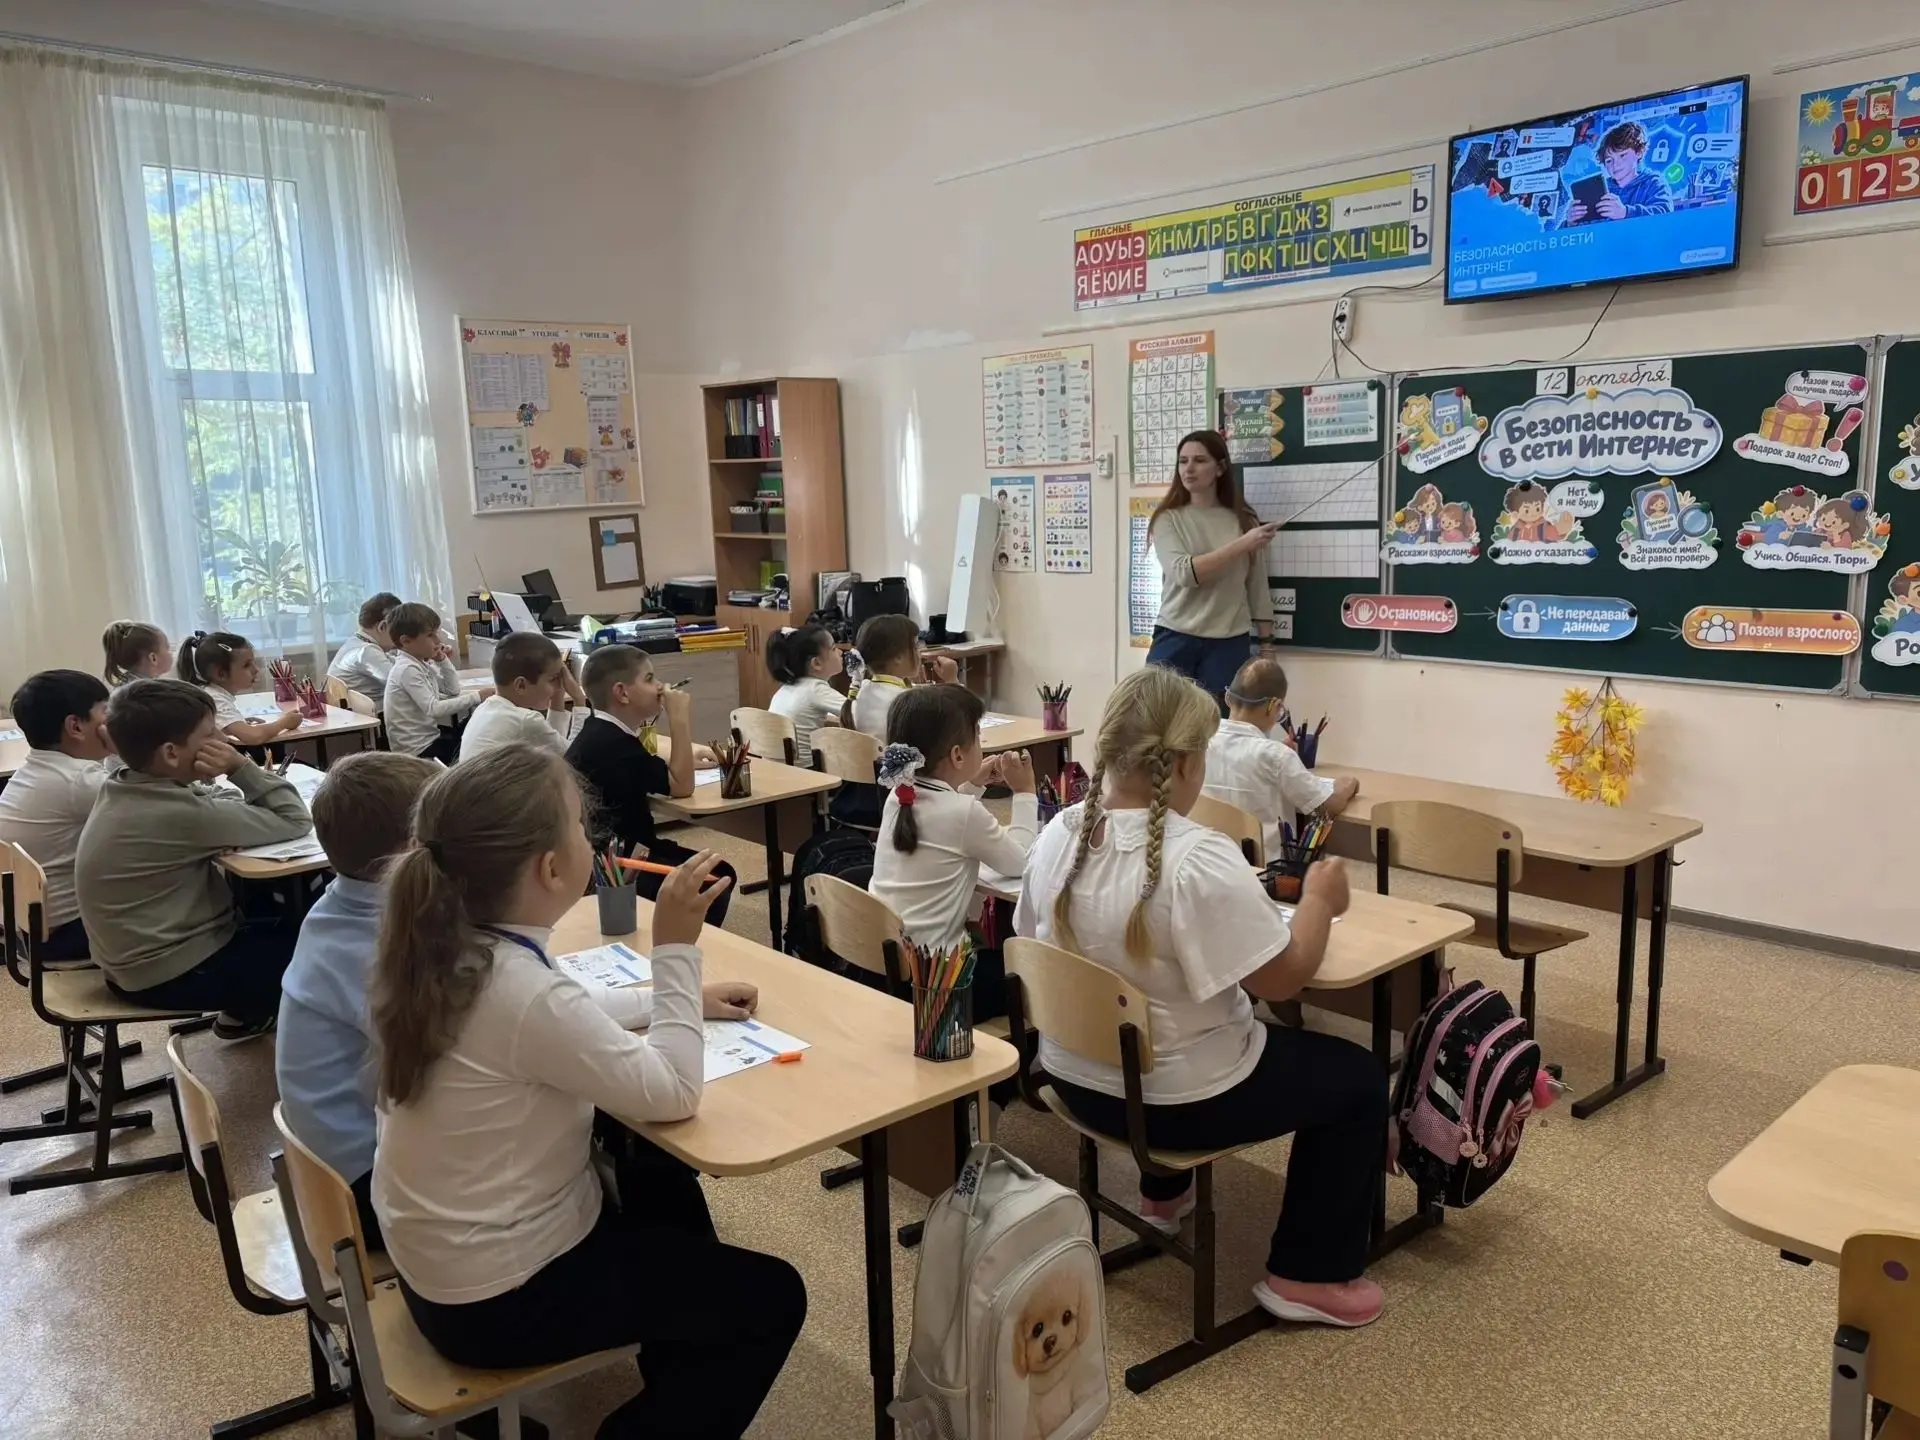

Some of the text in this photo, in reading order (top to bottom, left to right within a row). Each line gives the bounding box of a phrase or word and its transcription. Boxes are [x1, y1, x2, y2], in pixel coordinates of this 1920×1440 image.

[1234, 192, 1302, 212] СОГЛАСНЫЕ
[1089, 223, 1133, 238] ГЛАСНЫЕ
[1454, 232, 1594, 263] БЕЗОПАСНОСТЬ В СЕТИ
[1453, 259, 1514, 277] ИНТЕРНЕТ
[1139, 336, 1202, 350] РУССКИЙ АЛФАВИТ
[1543, 371, 1566, 392] 12
[1504, 409, 1692, 445] Безопасность
[1521, 435, 1572, 462] сети
[1578, 433, 1708, 460] Интернет
[1746, 440, 1783, 457] Подарок
[1784, 450, 1795, 459] за
[1817, 455, 1843, 468] Стоп!
[1567, 487, 1588, 497] Нет,
[1565, 498, 1577, 506] не
[1578, 496, 1599, 510] буду
[1388, 546, 1428, 559] Расскажи
[1499, 546, 1532, 557] Можно
[1679, 543, 1702, 554] имя?
[1630, 553, 1646, 563] Всё
[1674, 554, 1710, 566] проверь
[1753, 549, 1784, 561] Учись.
[1833, 553, 1870, 567] Твори.
[1379, 605, 1449, 622] Остановись
[1565, 608, 1628, 622] передавай
[1562, 621, 1609, 635] данные
[1738, 622, 1853, 642] Позови взрослого
